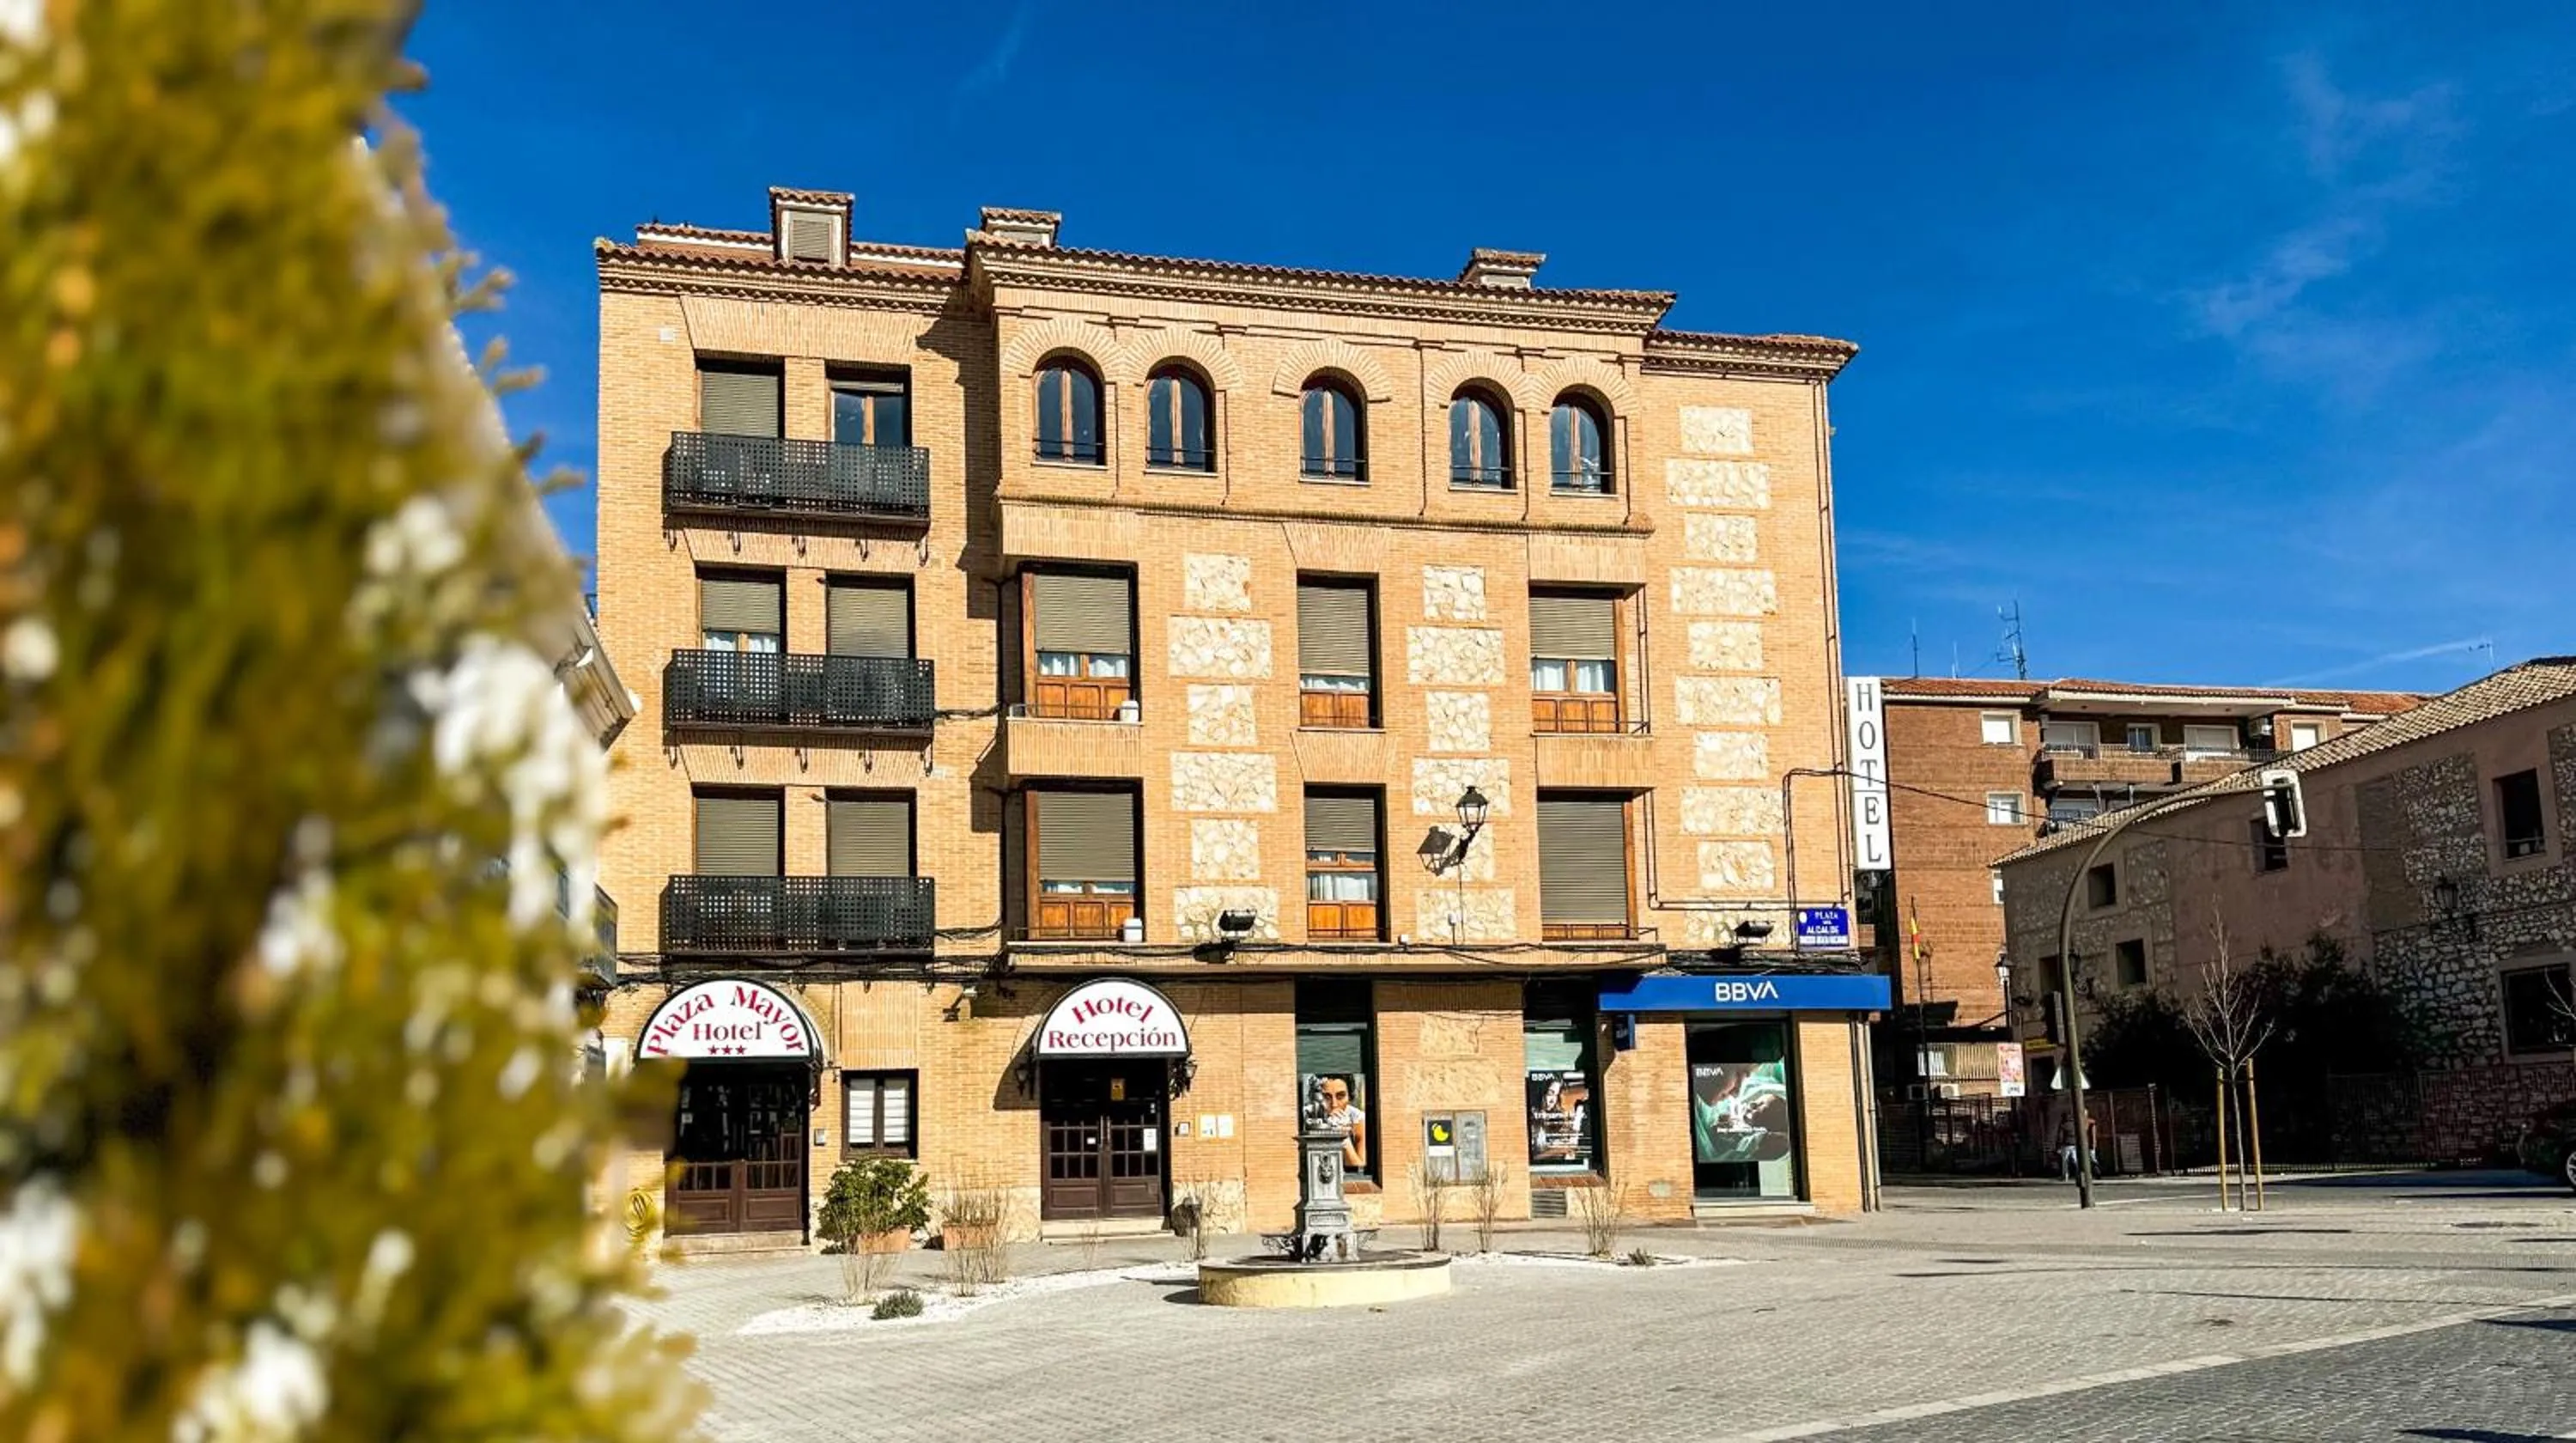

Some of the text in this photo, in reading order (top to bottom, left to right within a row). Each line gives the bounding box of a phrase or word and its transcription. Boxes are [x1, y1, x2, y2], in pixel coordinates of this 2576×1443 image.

[1856, 683, 1882, 863] HOTEL
[1716, 980, 1778, 1002] BBVA
[647, 985, 805, 1056] Plaza Mayor
[1072, 996, 1154, 1025] Hotel
[693, 1020, 762, 1041] Hotel
[1048, 1026, 1178, 1052] Recepción
[1531, 1072, 1554, 1081] BBVA
[1696, 1066, 1723, 1077] BBVA
